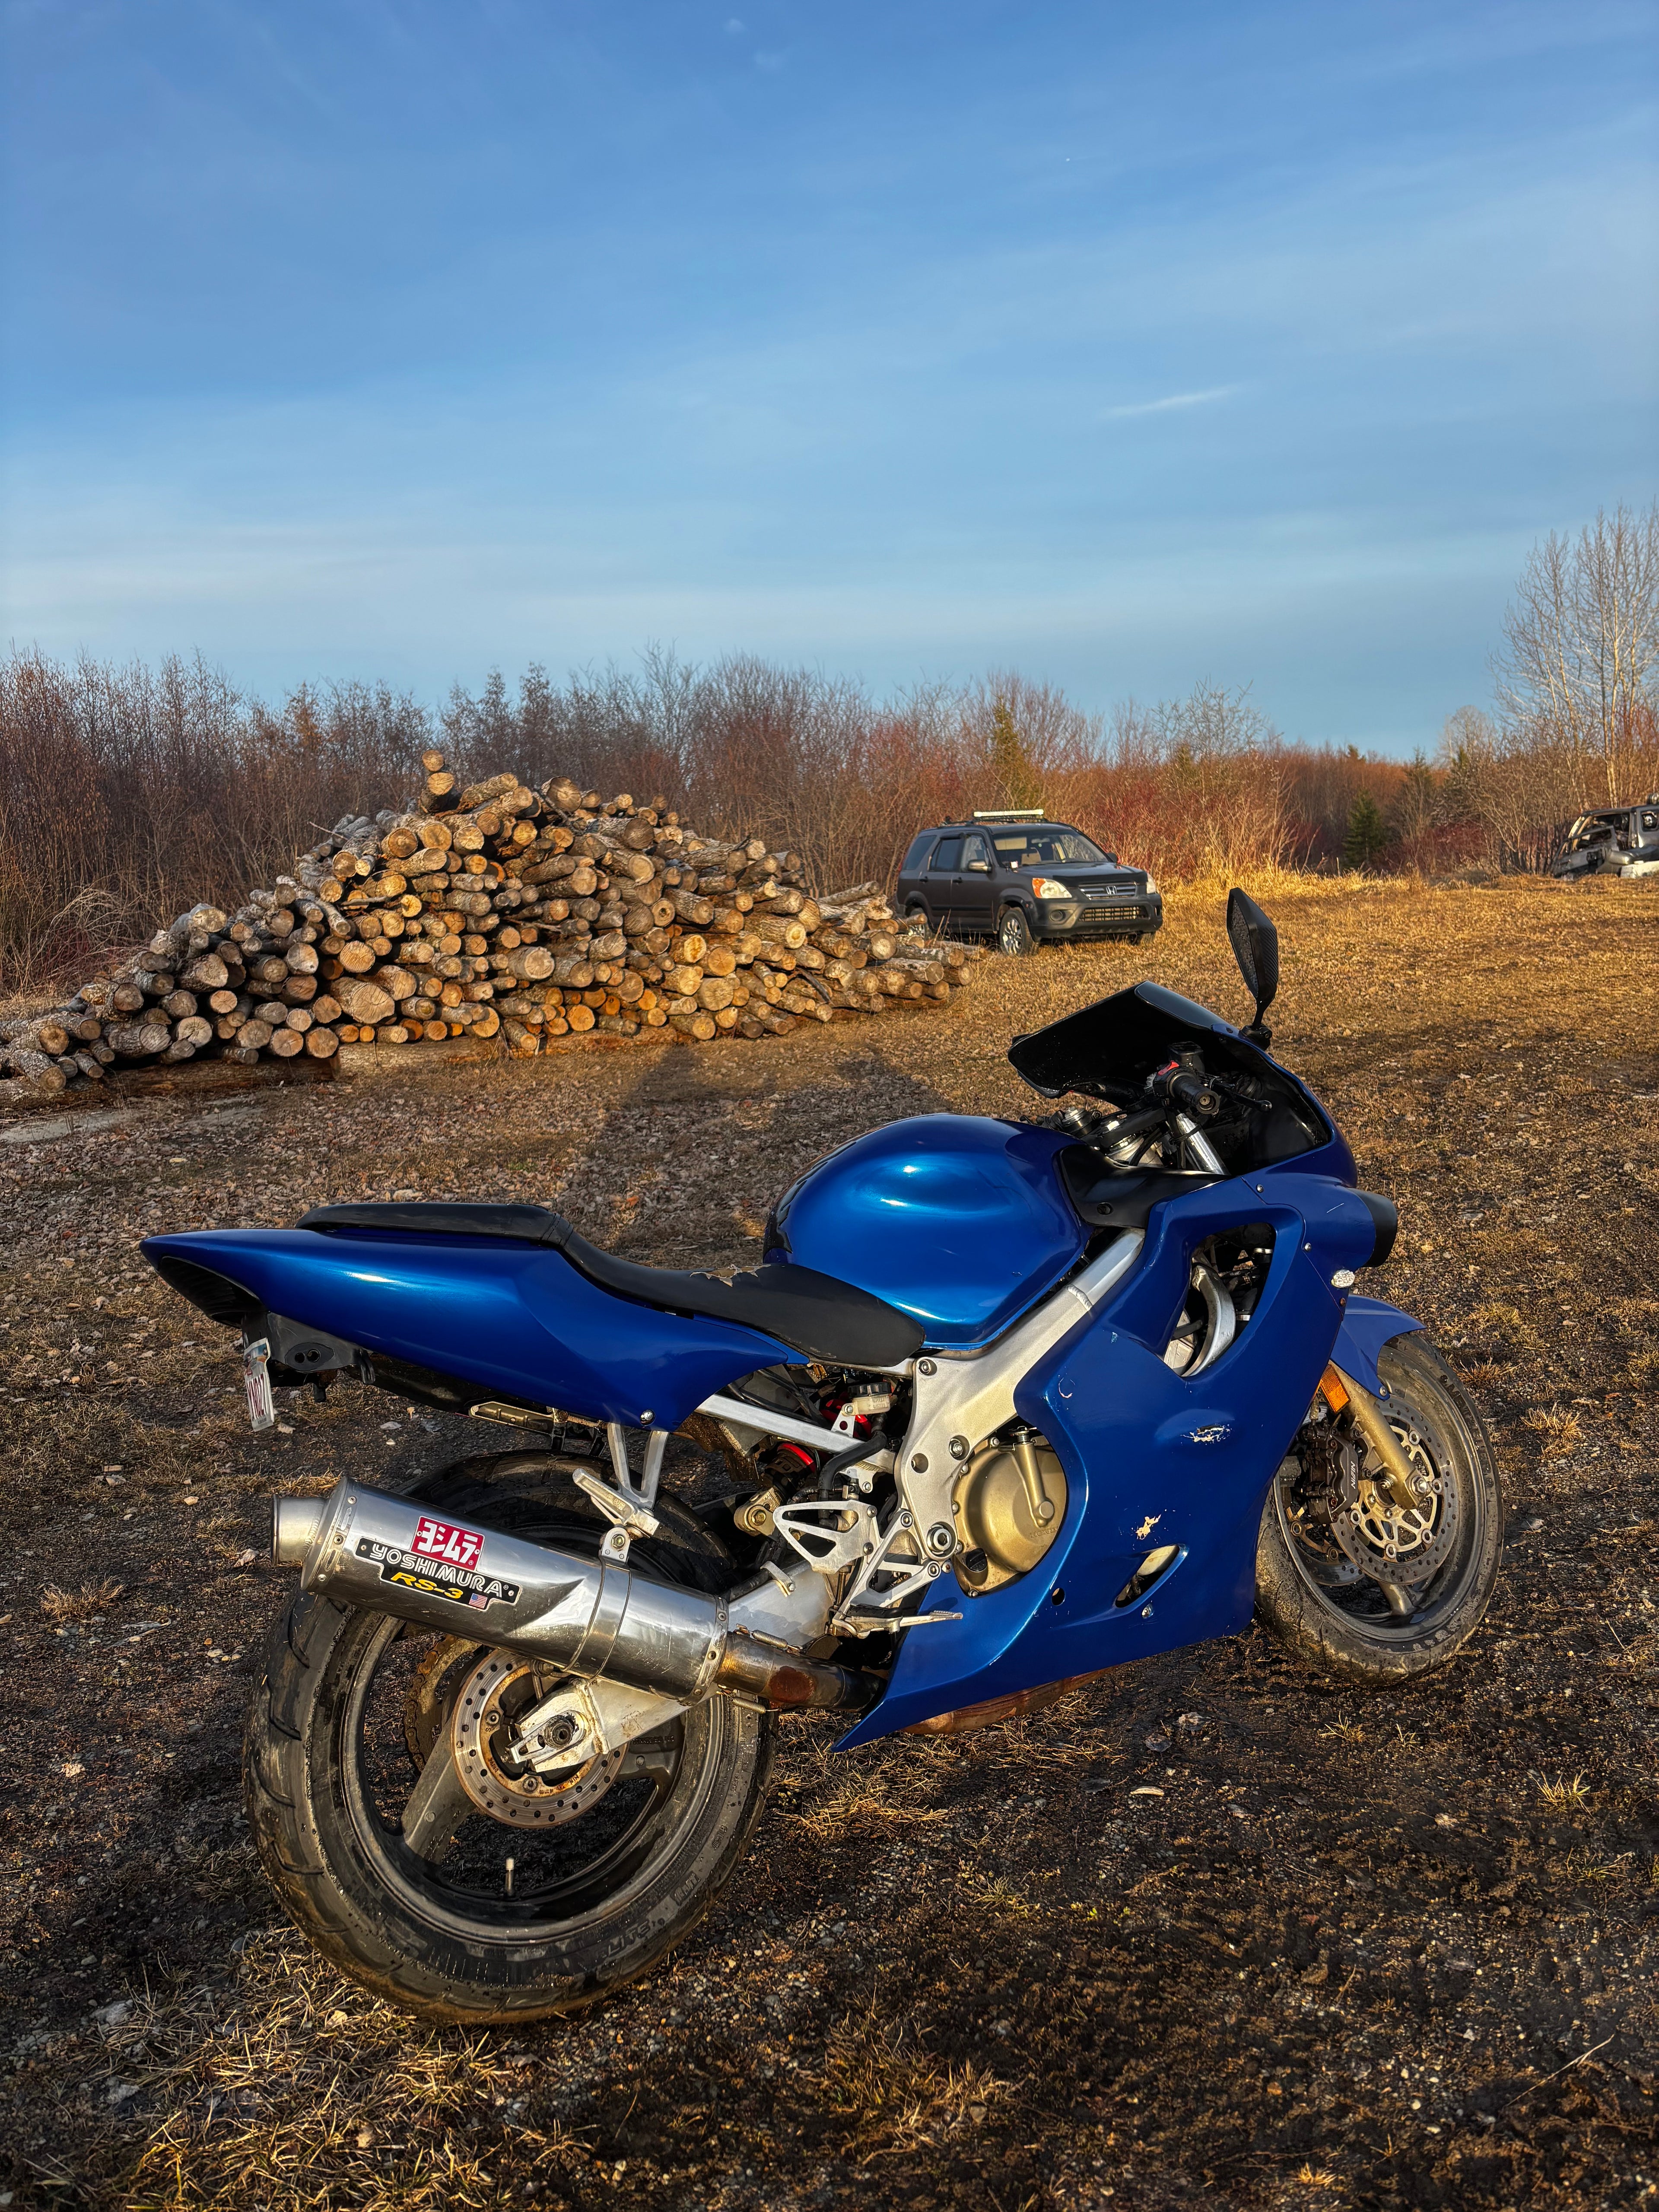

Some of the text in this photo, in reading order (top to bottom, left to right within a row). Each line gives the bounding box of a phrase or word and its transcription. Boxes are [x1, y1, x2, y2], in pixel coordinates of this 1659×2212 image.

[417, 1521, 478, 1564] ヨシムラ
[369, 1544, 502, 1598] YOSHIMURA
[391, 1572, 464, 1599] RS-3
